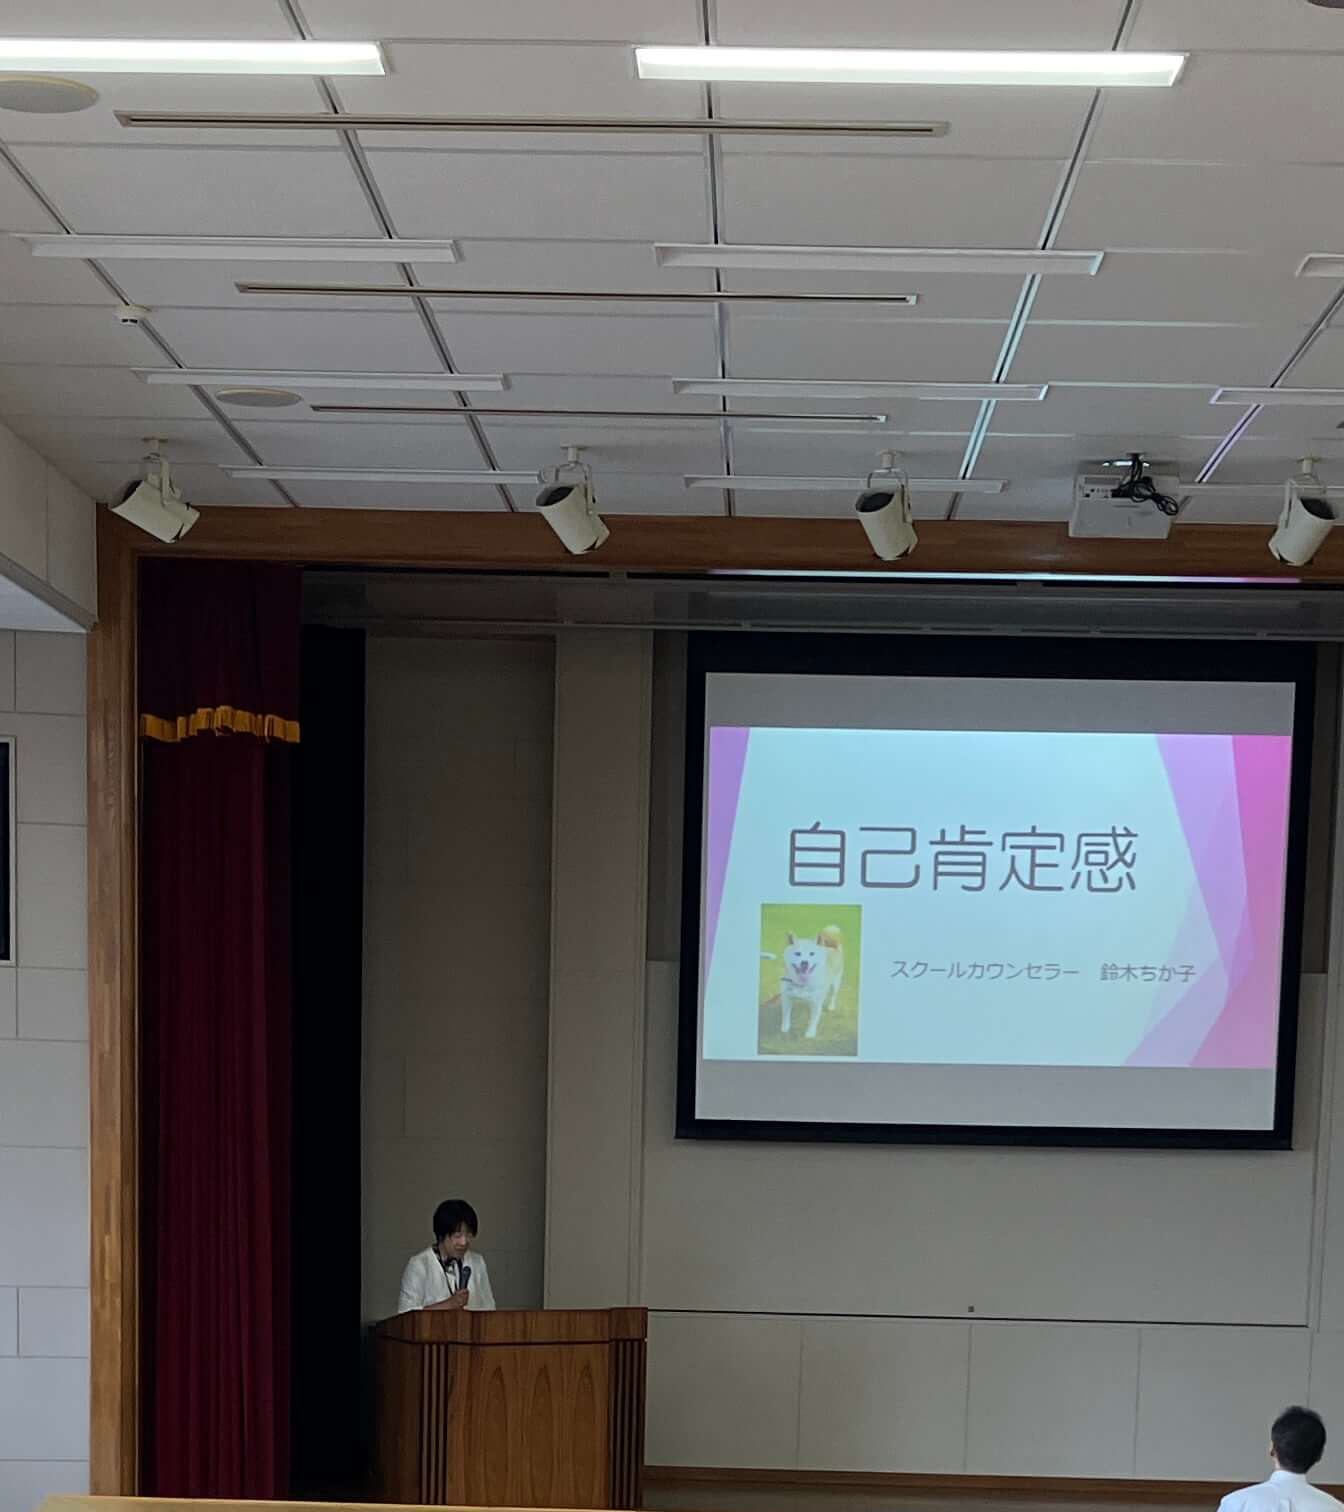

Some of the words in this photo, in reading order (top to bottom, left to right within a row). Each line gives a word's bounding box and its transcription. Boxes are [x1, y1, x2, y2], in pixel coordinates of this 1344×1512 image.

[788, 821, 1139, 892] 自己肯定感
[890, 960, 1080, 980] スクールカウンセラー
[1099, 962, 1197, 983] 鈴木ちか子
